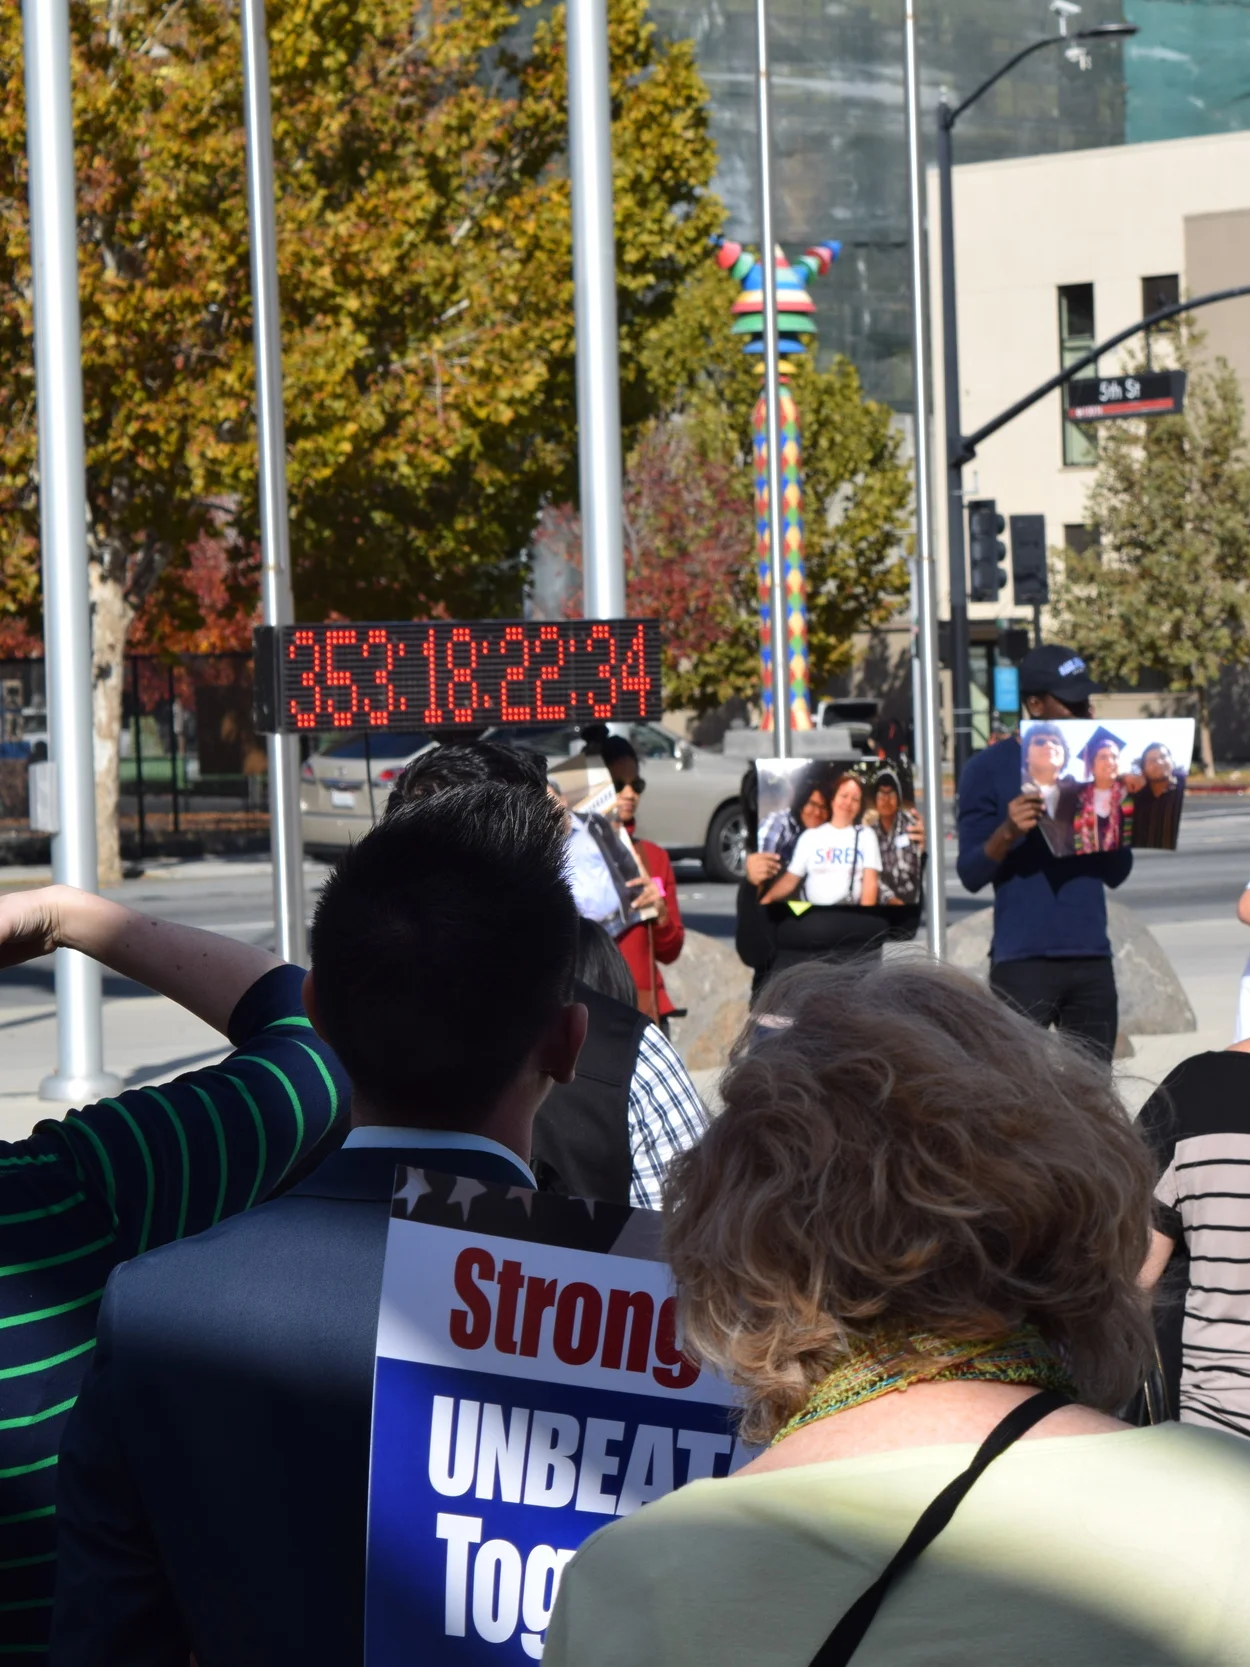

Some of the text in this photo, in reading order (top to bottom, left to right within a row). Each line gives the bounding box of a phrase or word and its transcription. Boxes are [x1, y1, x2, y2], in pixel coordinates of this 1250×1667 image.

[1098, 378, 1141, 402] 5th St
[289, 624, 651, 728] 353:18:22:34
[449, 1247, 701, 1389] Strong
[428, 1395, 758, 1515] UNBEAT
